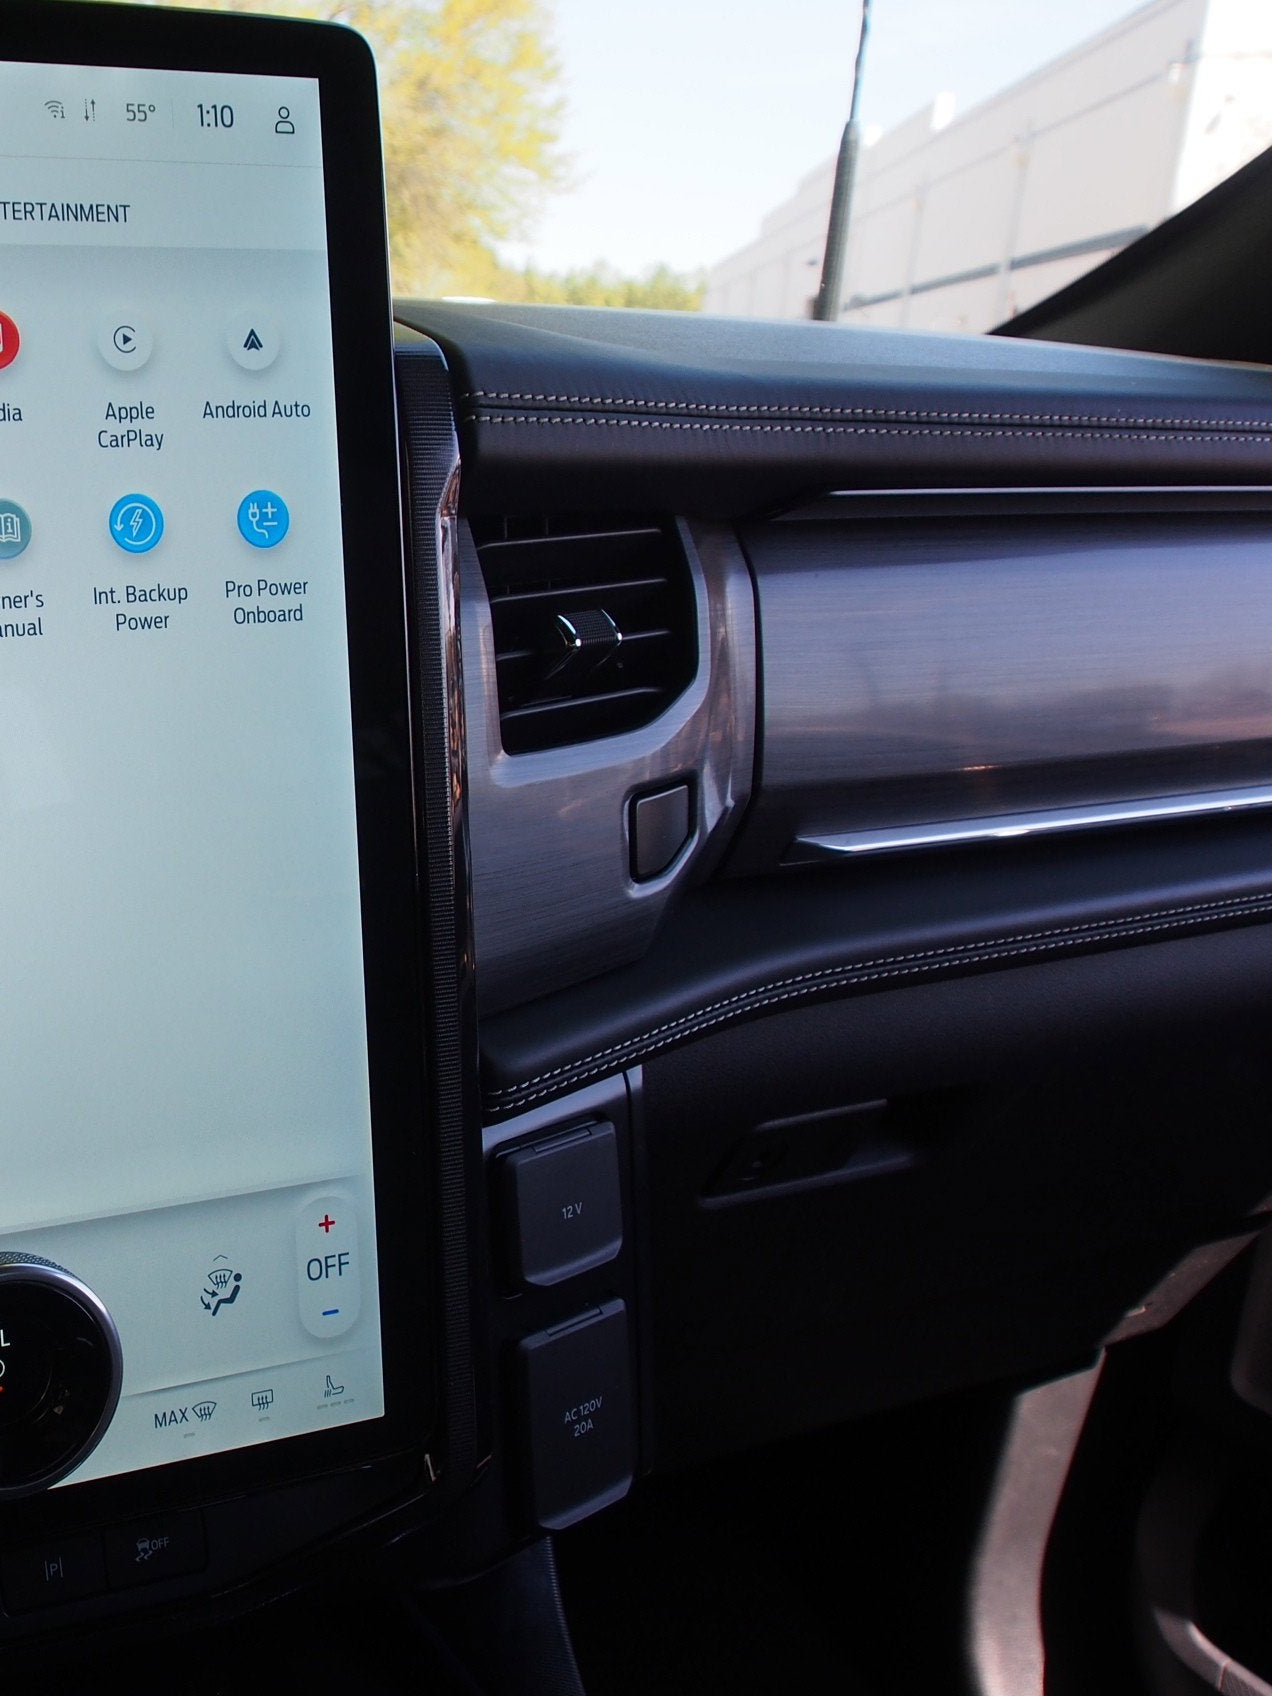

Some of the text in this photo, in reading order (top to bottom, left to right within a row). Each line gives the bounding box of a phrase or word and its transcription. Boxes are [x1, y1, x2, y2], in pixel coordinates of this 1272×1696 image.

[126, 103, 156, 123] 55°
[197, 103, 234, 128] 1:10
[105, 400, 155, 424] Apple
[202, 399, 311, 419] Android Auto
[97, 428, 164, 451] CarPlay
[93, 583, 188, 605] Int. Backup
[225, 579, 309, 599] Pro Power
[115, 613, 170, 632] Power
[233, 603, 304, 625] Onboard
[306, 1251, 350, 1282] OFF
[154, 1407, 189, 1429] MAX
[564, 1396, 603, 1424] AC 120V
[573, 1418, 594, 1437] 20A
